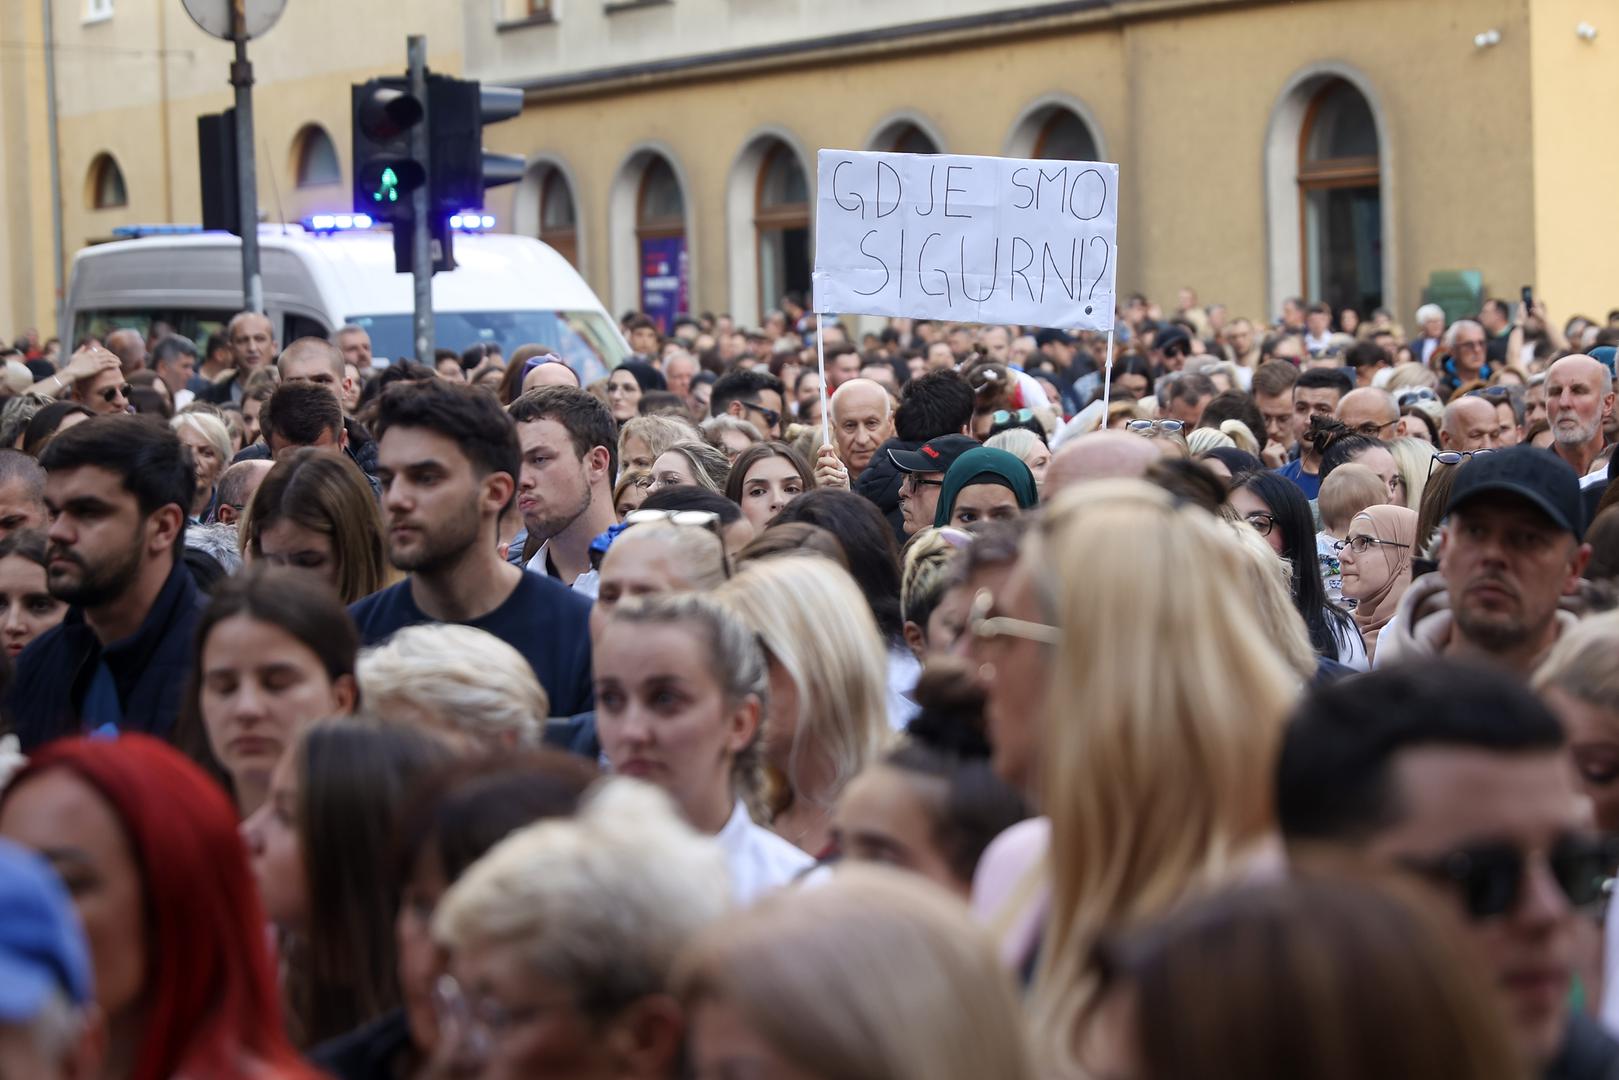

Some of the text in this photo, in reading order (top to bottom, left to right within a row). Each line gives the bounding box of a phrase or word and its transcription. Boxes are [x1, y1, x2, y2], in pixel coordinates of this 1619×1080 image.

[832, 160, 1107, 221] GDJE SMO
[853, 229, 1109, 316] SIGURNI?
